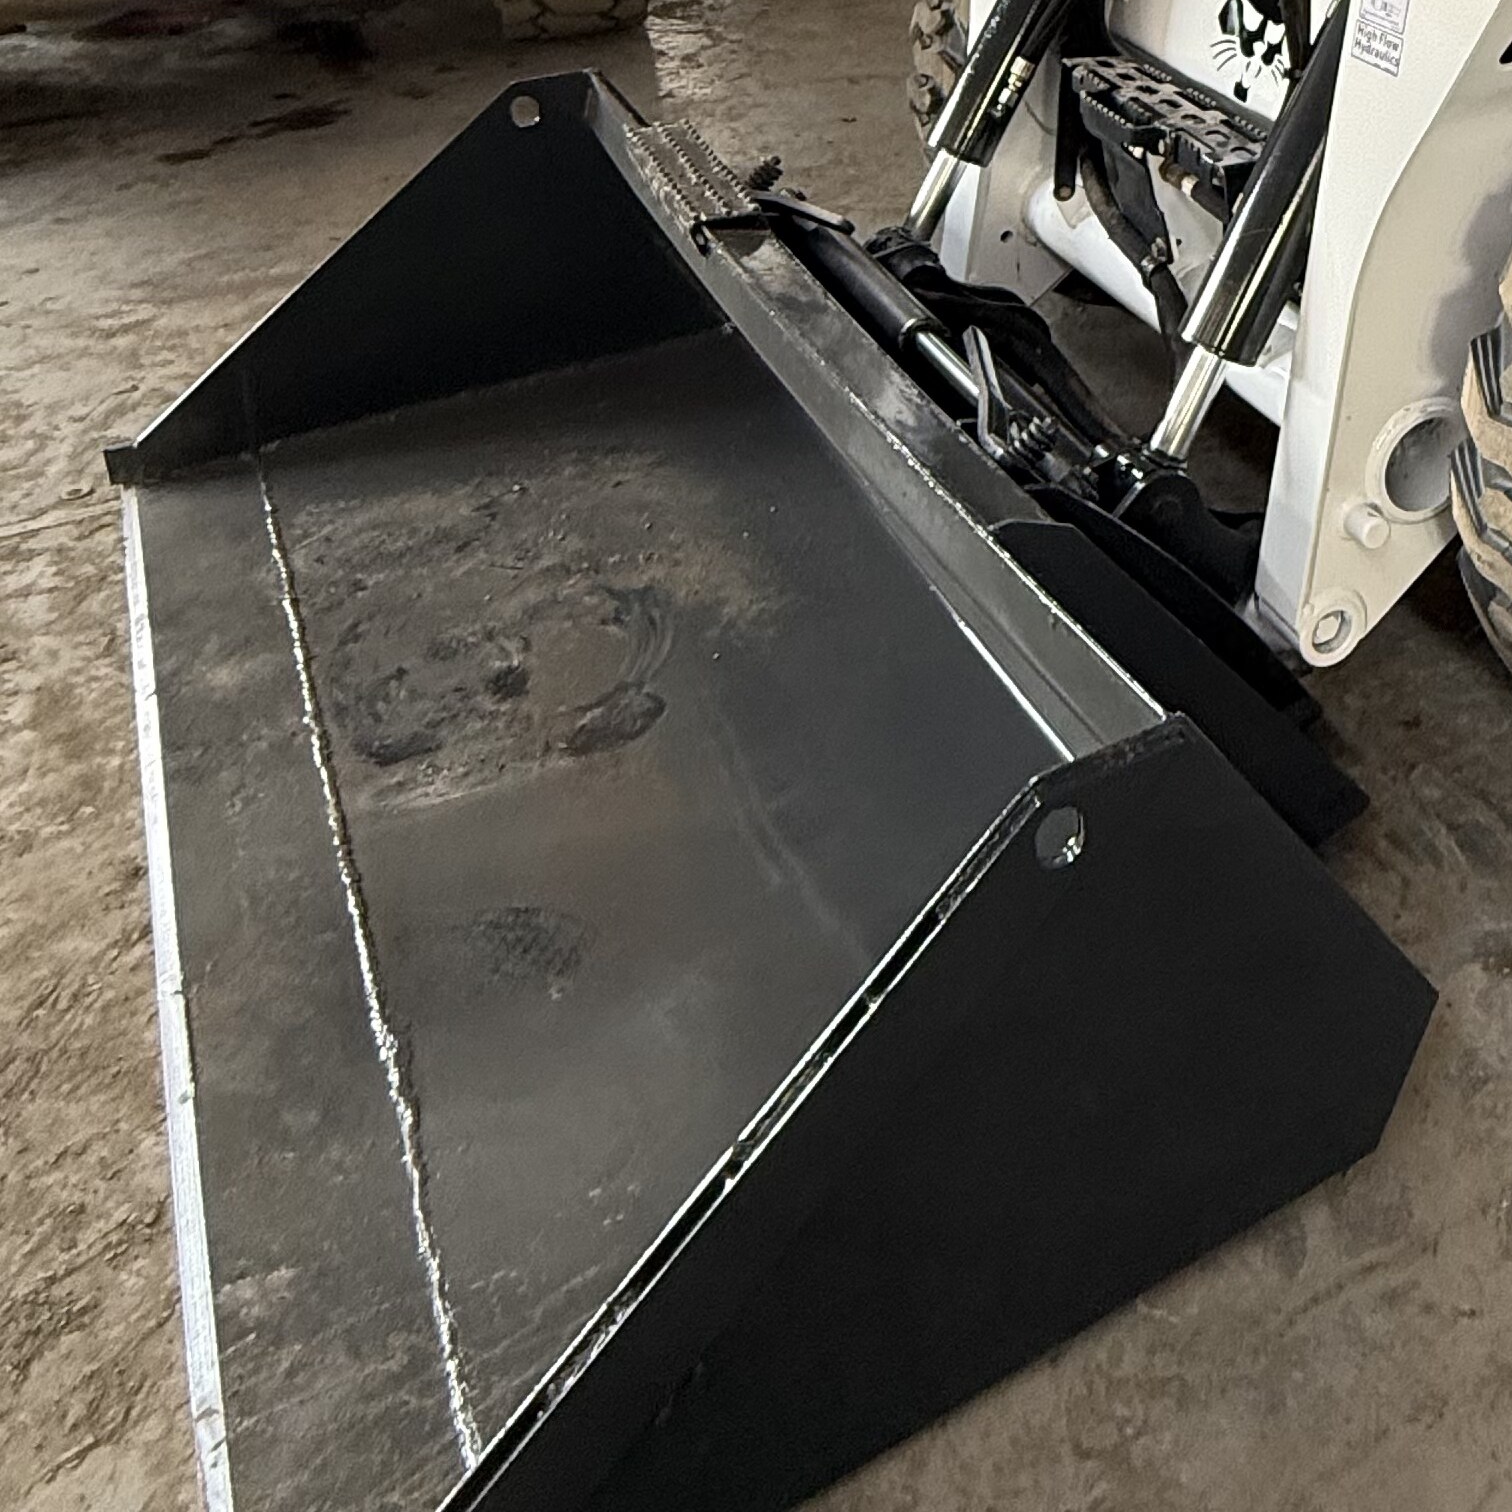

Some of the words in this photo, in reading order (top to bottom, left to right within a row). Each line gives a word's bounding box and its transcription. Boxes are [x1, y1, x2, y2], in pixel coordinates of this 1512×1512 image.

[1354, 37, 1400, 68] Hydraulics
[1357, 23, 1378, 44] High
[1379, 31, 1400, 52] Flow
